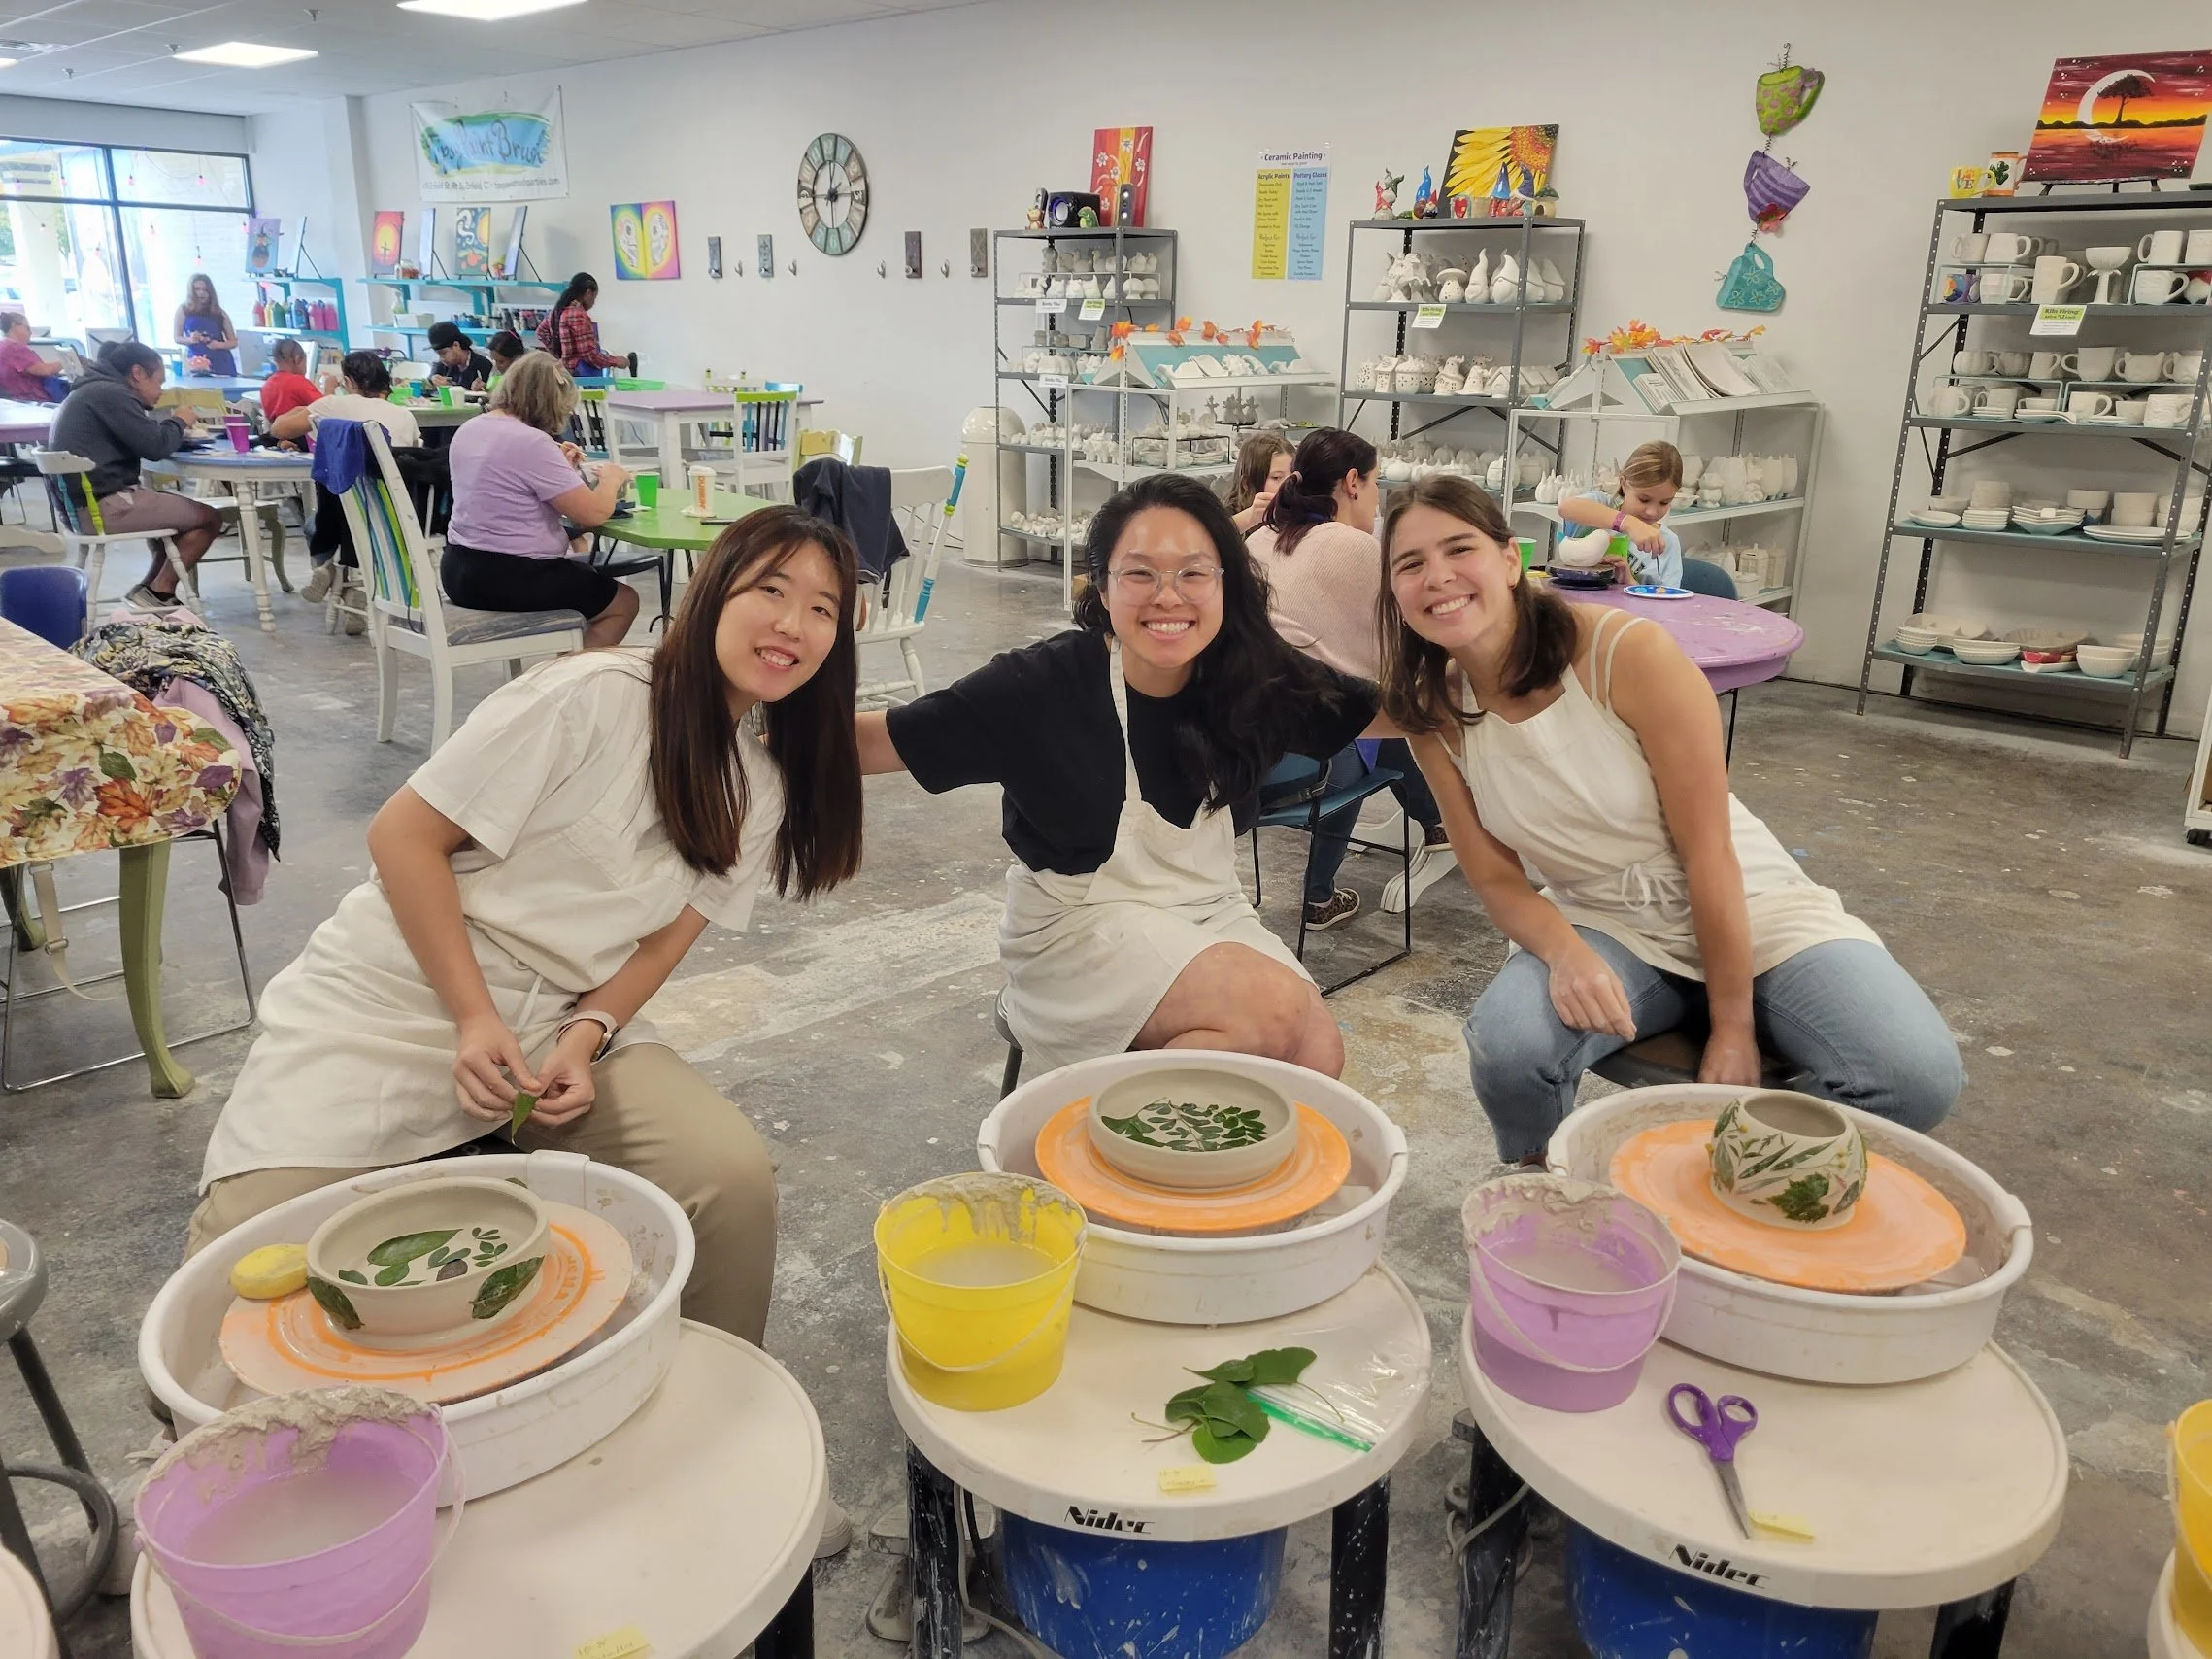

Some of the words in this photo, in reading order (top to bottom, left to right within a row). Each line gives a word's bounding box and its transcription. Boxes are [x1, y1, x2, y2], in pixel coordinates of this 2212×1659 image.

[1264, 152, 1292, 161] Ceramic
[1292, 152, 1323, 161] Painting
[1064, 1505, 1156, 1535] Nidec
[1668, 1543, 1771, 1590] Nidec
